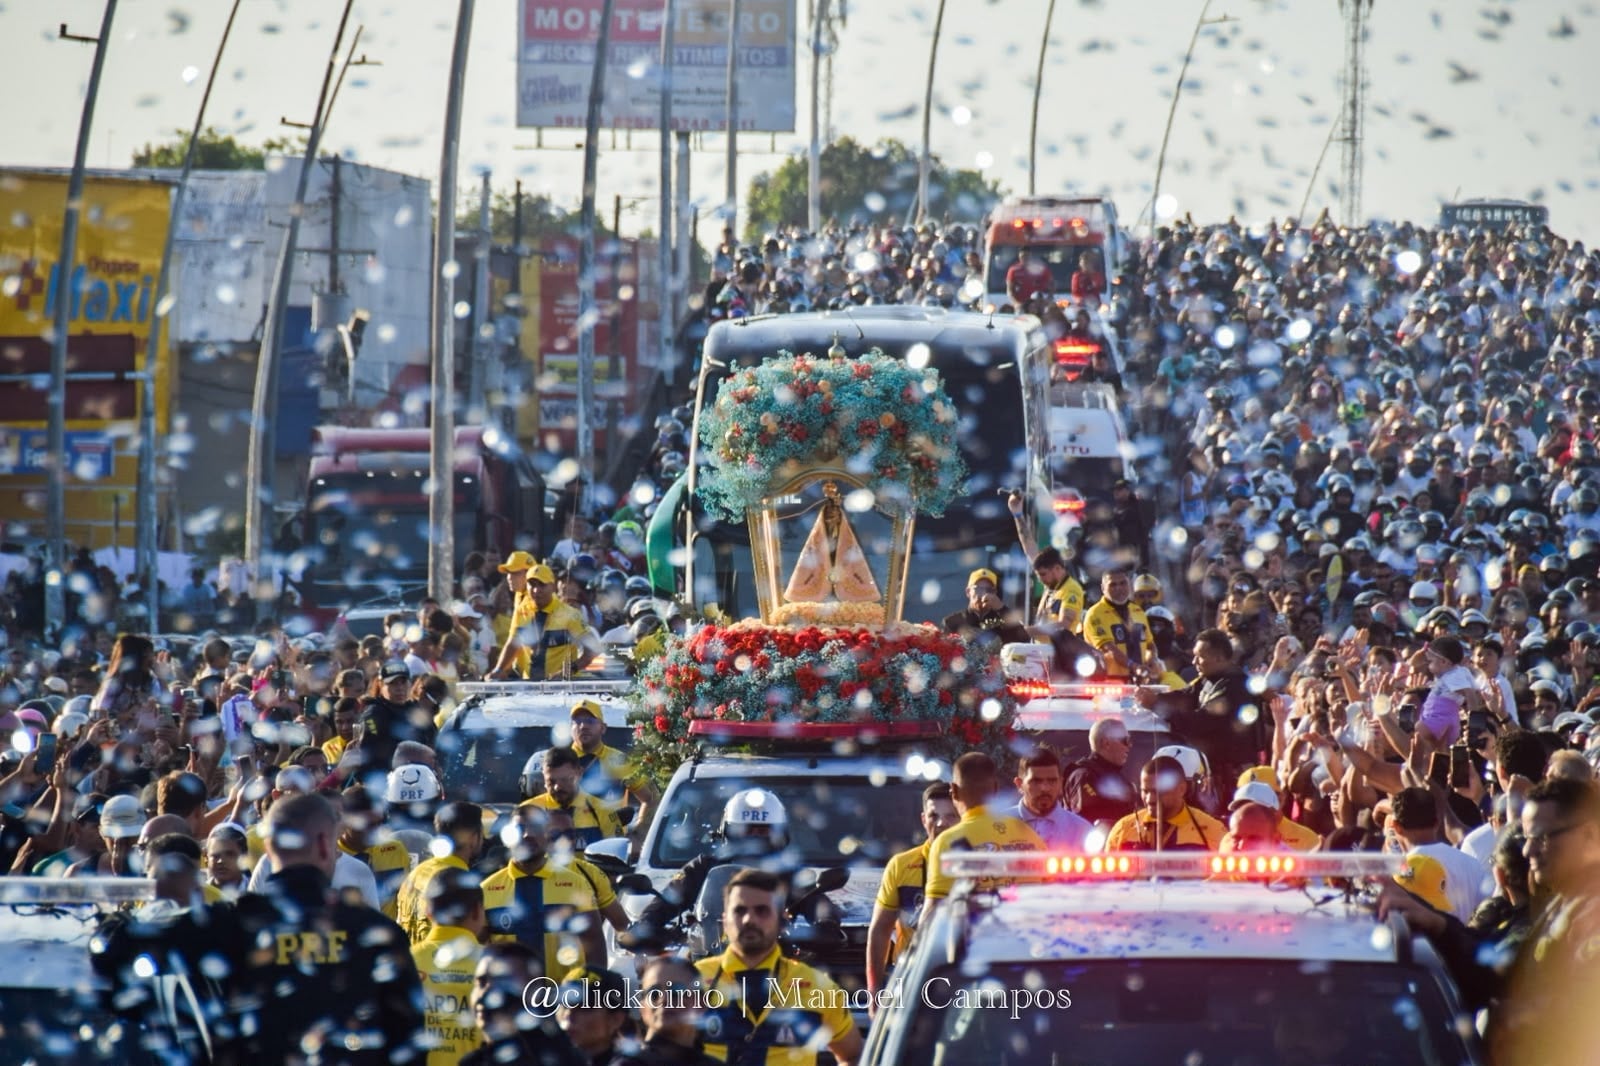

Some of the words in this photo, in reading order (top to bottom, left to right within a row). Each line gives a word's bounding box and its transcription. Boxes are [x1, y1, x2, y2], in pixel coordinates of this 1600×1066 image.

[400, 789, 425, 800] PRF
[741, 810, 769, 821] PRF
[276, 929, 348, 965] PRF
